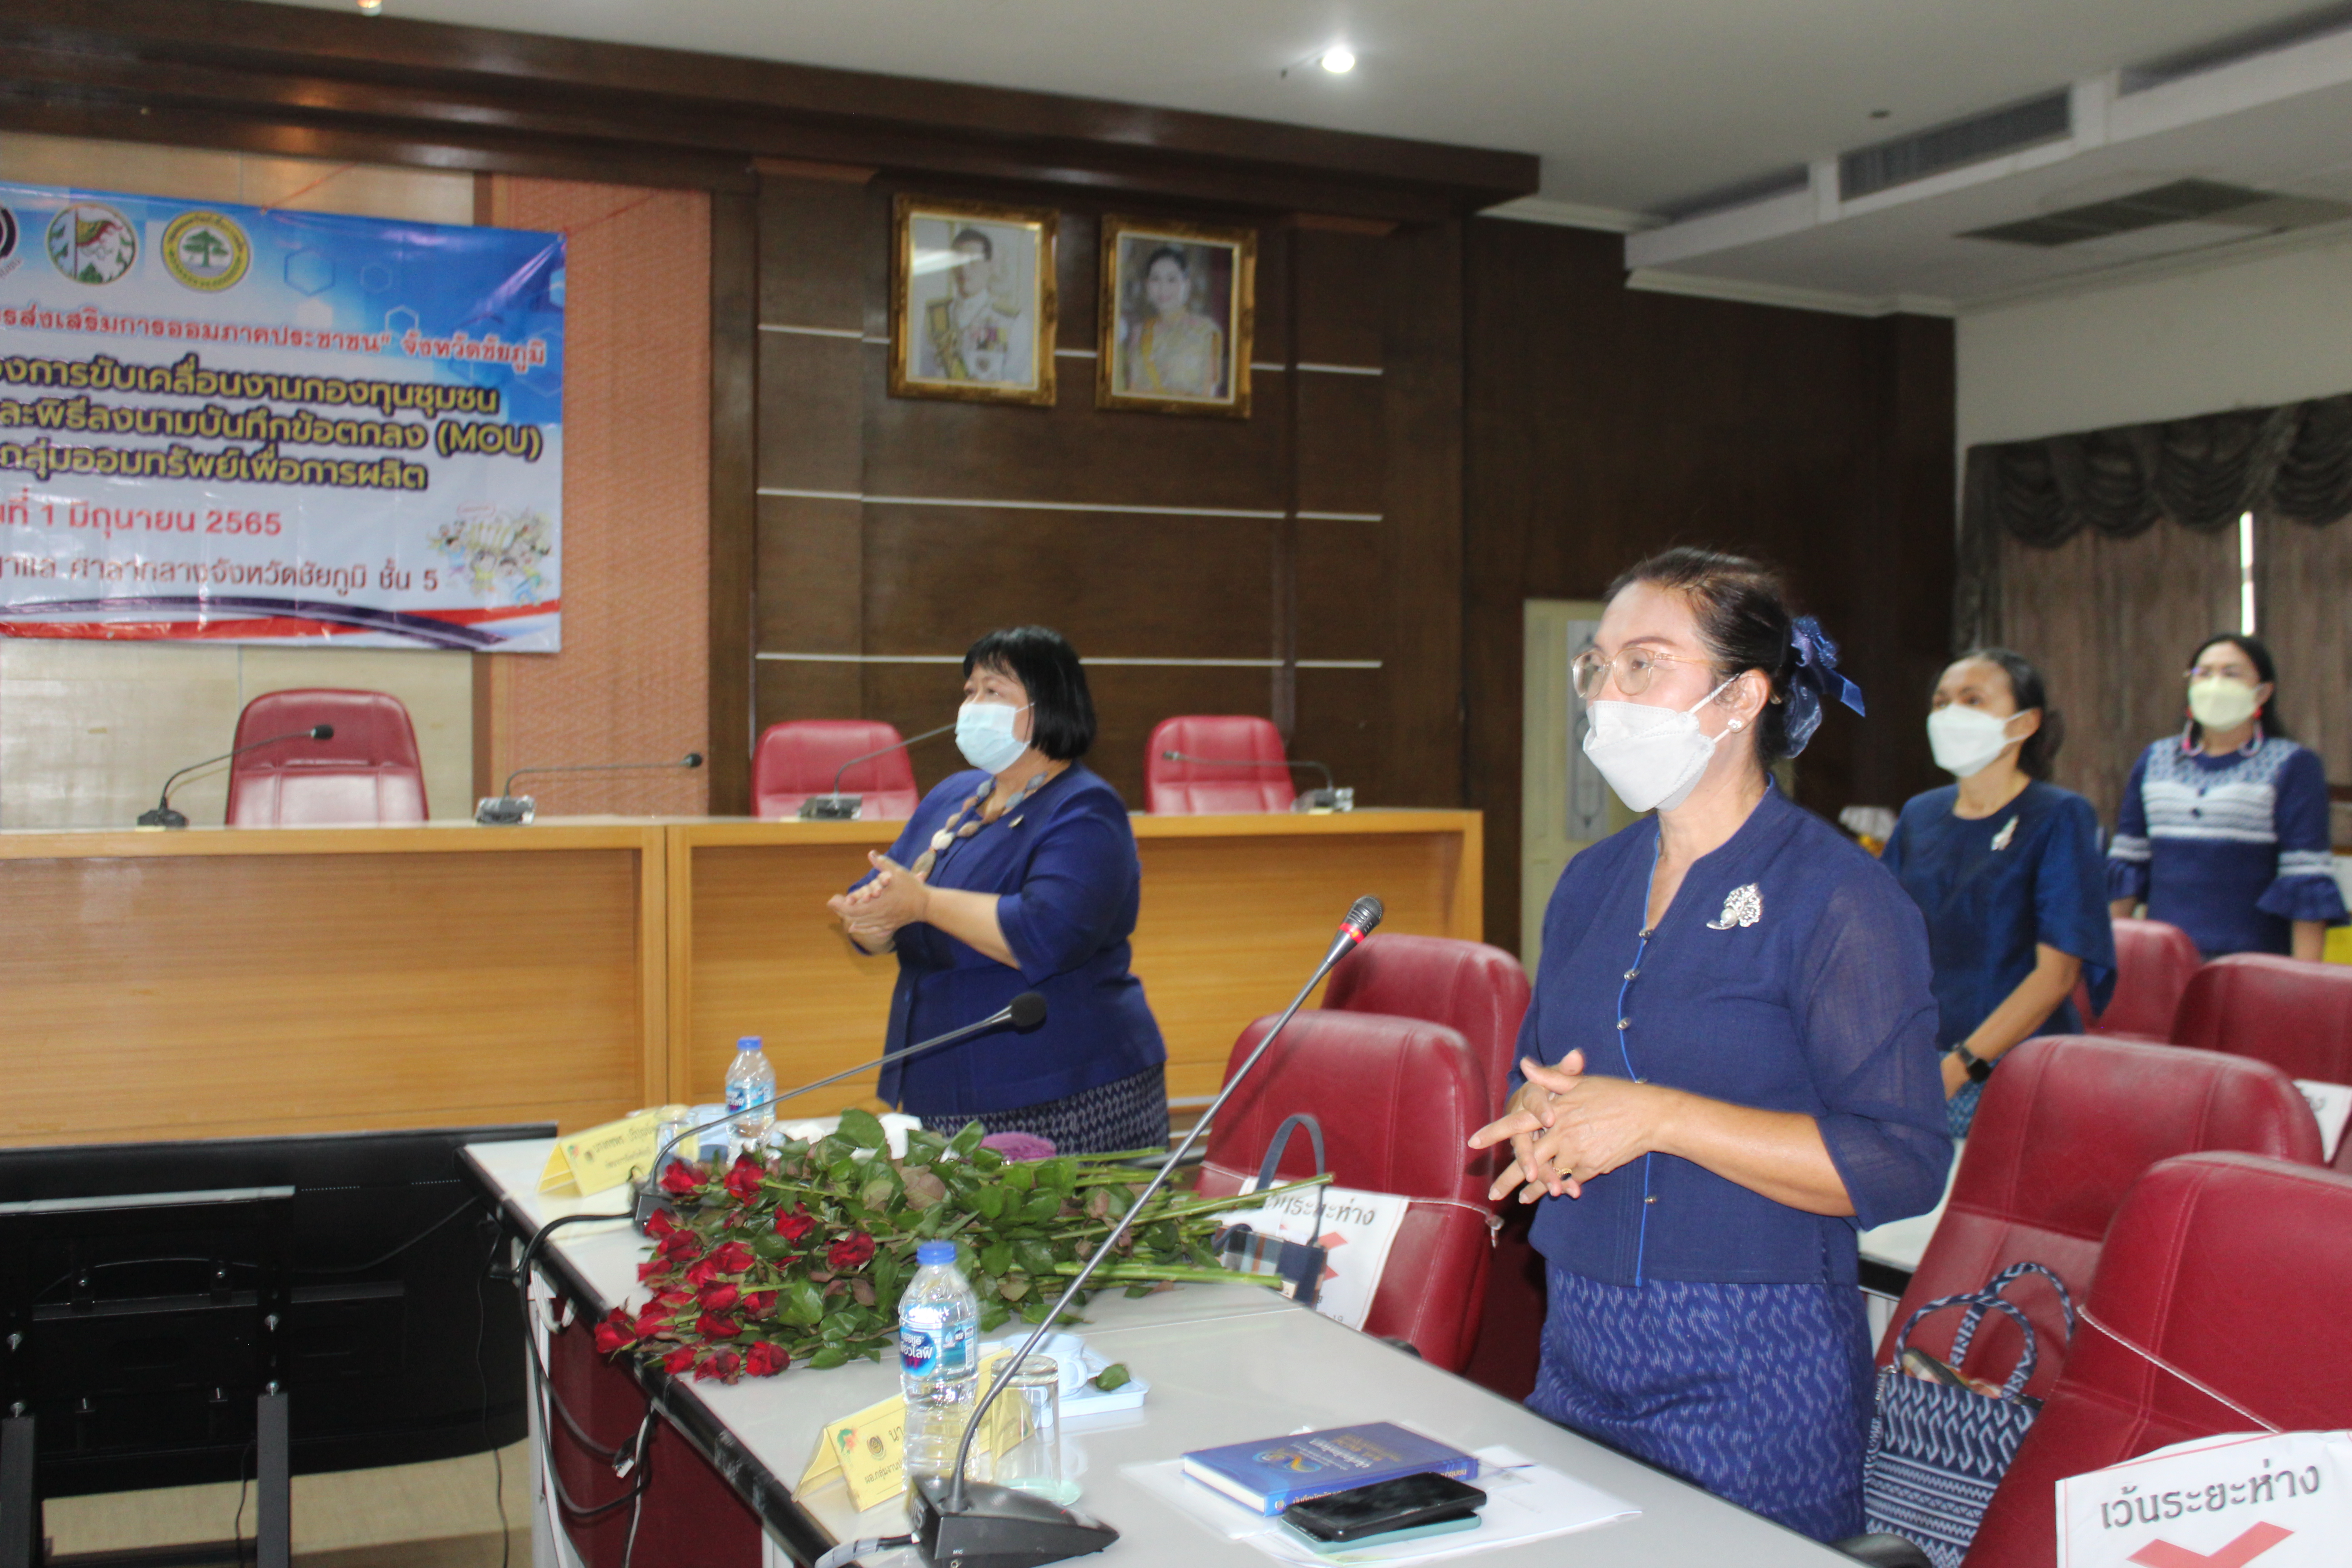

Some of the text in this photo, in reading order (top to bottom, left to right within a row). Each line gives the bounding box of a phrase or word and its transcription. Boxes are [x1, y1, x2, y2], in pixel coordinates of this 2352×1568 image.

[0, 304, 545, 373] รส่งเสริมการออมภาคประชาชน" จังหวัดชัยภูมิ
[0, 355, 497, 417] งการขับเคลื่อนงานกองทุนชุมชน
[437, 422, 541, 461] (MOU)
[0, 487, 282, 538] ที่ 1 มิถุนายน 2565
[0, 557, 55, 579] าแล
[380, 557, 411, 591] ชั้น
[424, 569, 439, 591] 5
[955, 1333, 964, 1341] NSF
[2101, 1459, 2321, 1529] เว้นระยะห่าง
